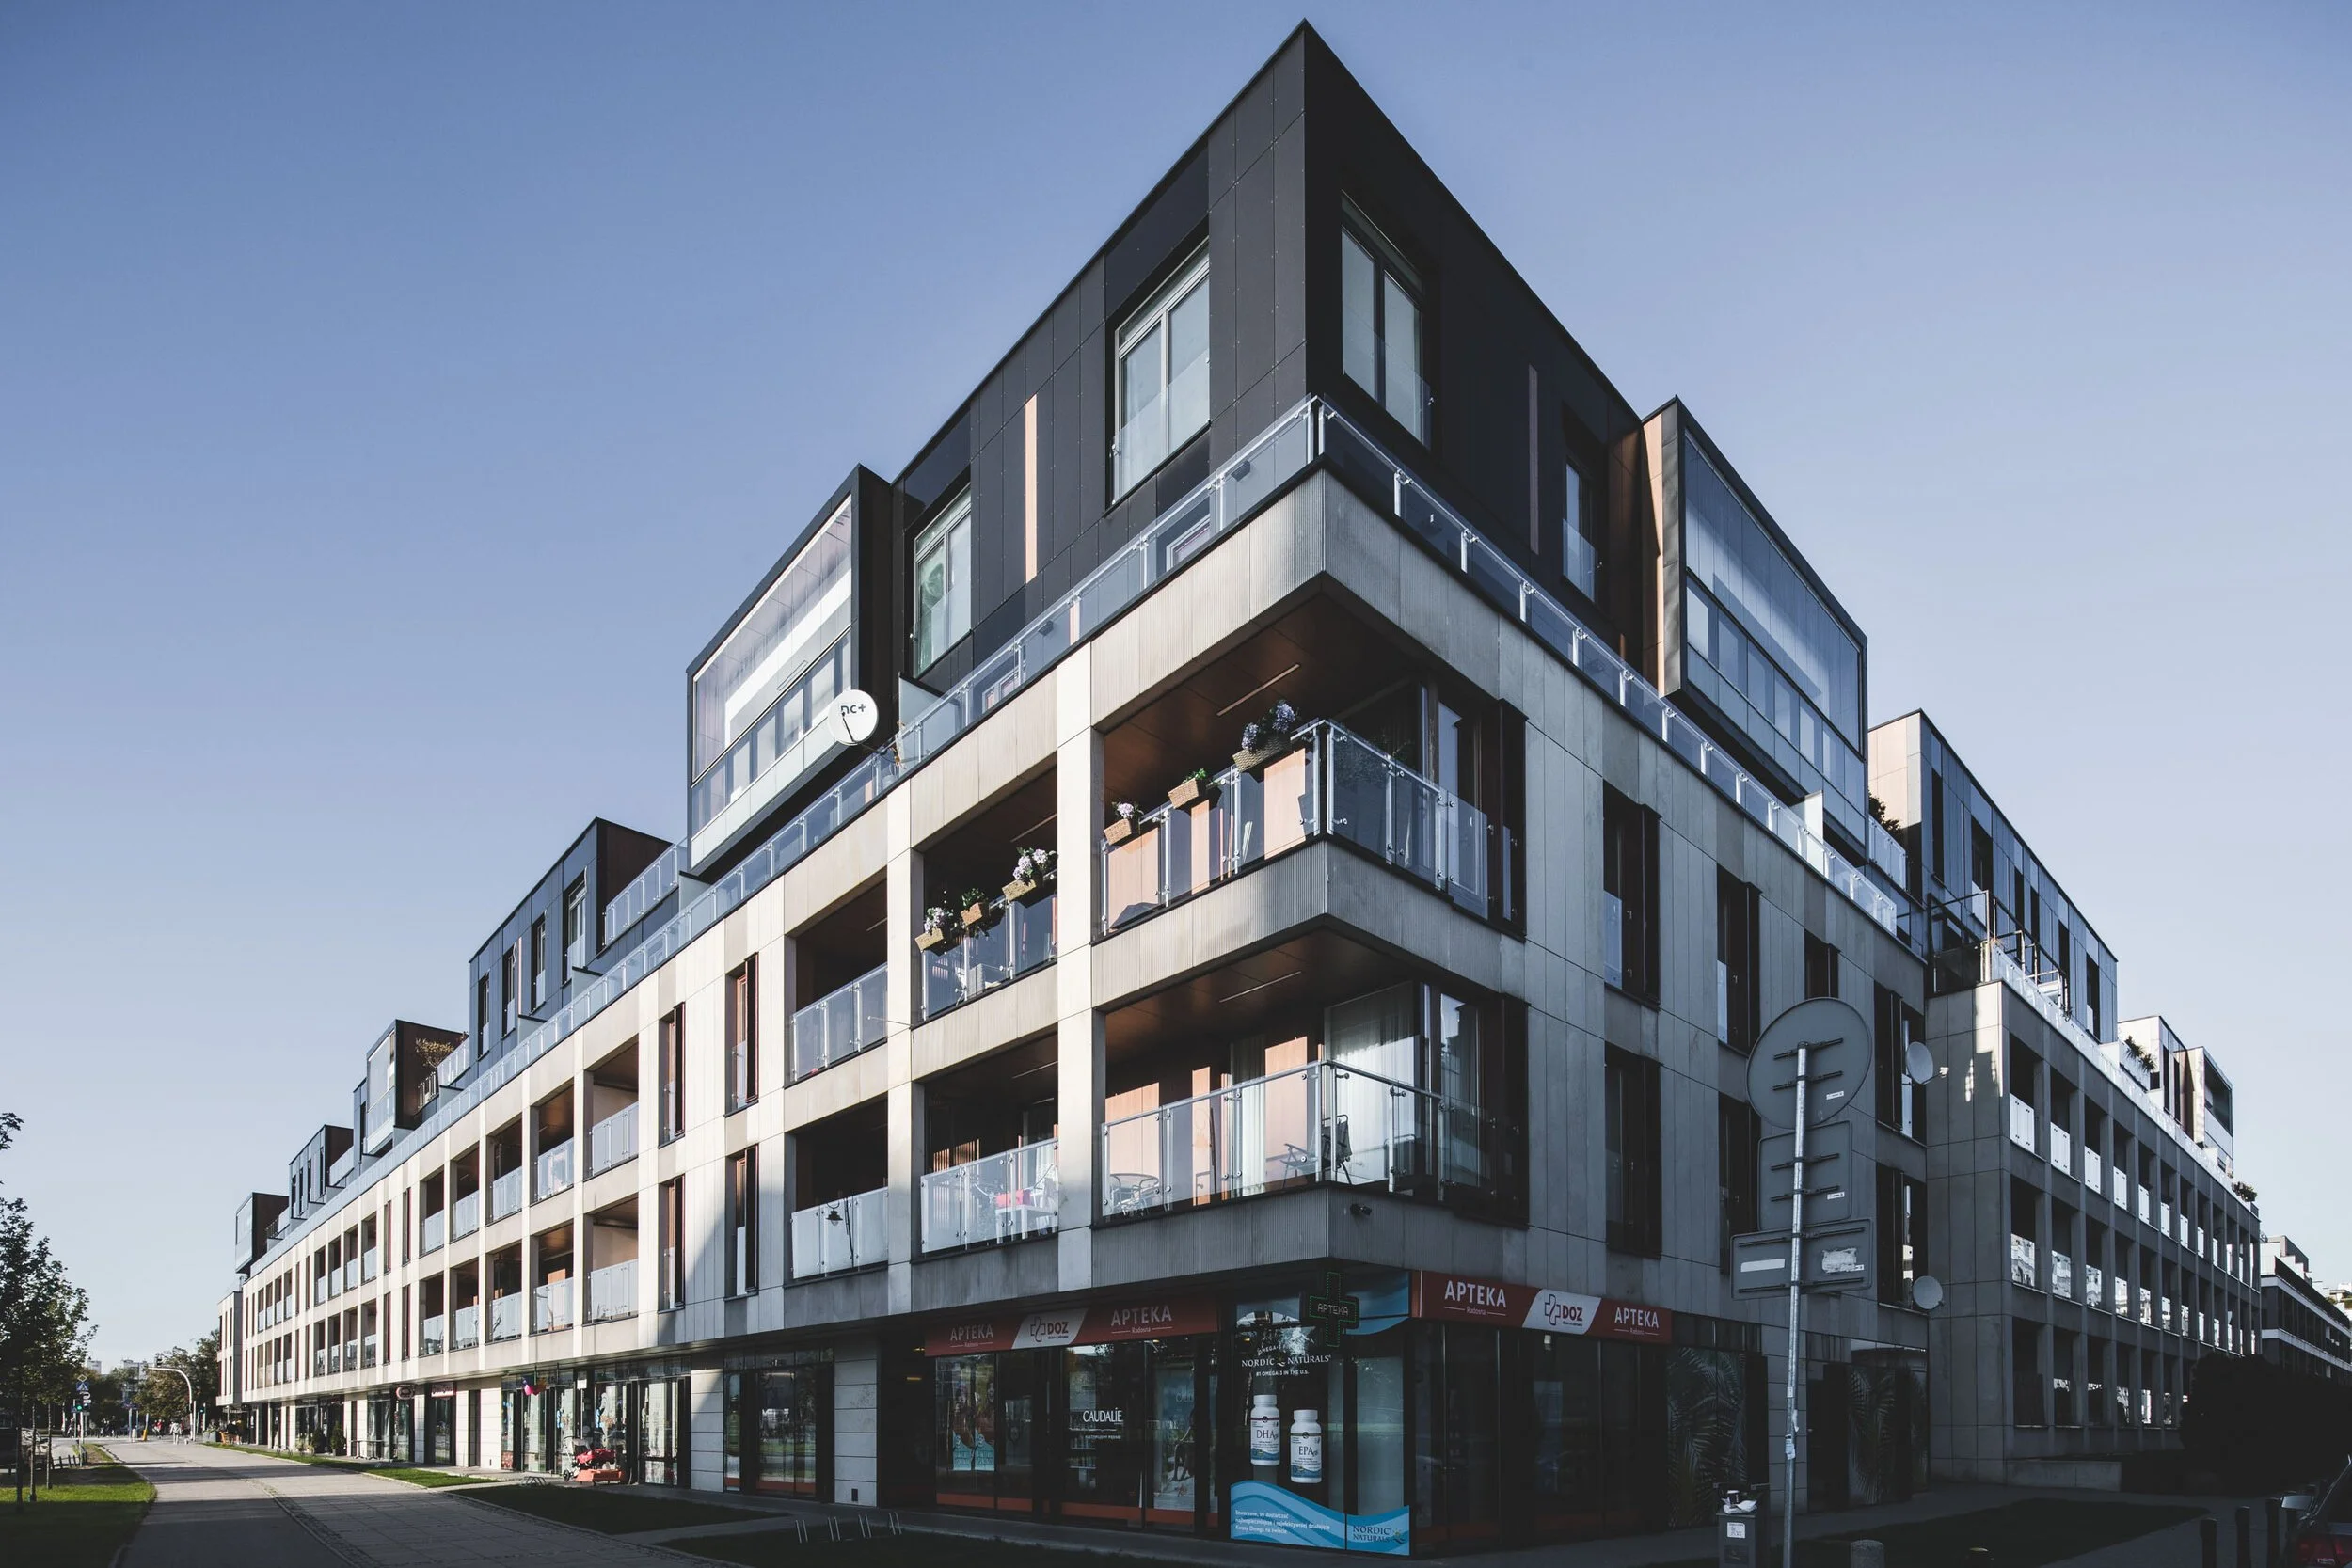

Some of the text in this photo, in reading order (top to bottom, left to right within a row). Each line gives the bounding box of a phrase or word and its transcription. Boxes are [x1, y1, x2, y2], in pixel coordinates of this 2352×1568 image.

[841, 704, 866, 714] nc+
[1444, 1280, 1506, 1307] APTEKA
[1111, 1305, 1172, 1326] APTEKA
[1317, 1303, 1349, 1316] APTEKA
[1562, 1305, 1583, 1322] DOZ
[1614, 1307, 1659, 1328] APTEKA
[949, 1323, 993, 1341] APTEKA
[1047, 1321, 1069, 1335] DOZ
[1241, 1357, 1275, 1368] NORDIC
[1257, 1430, 1275, 1439] DHA
[1298, 1446, 1313, 1456] EPA
[1353, 1526, 1391, 1535] NORDIC
